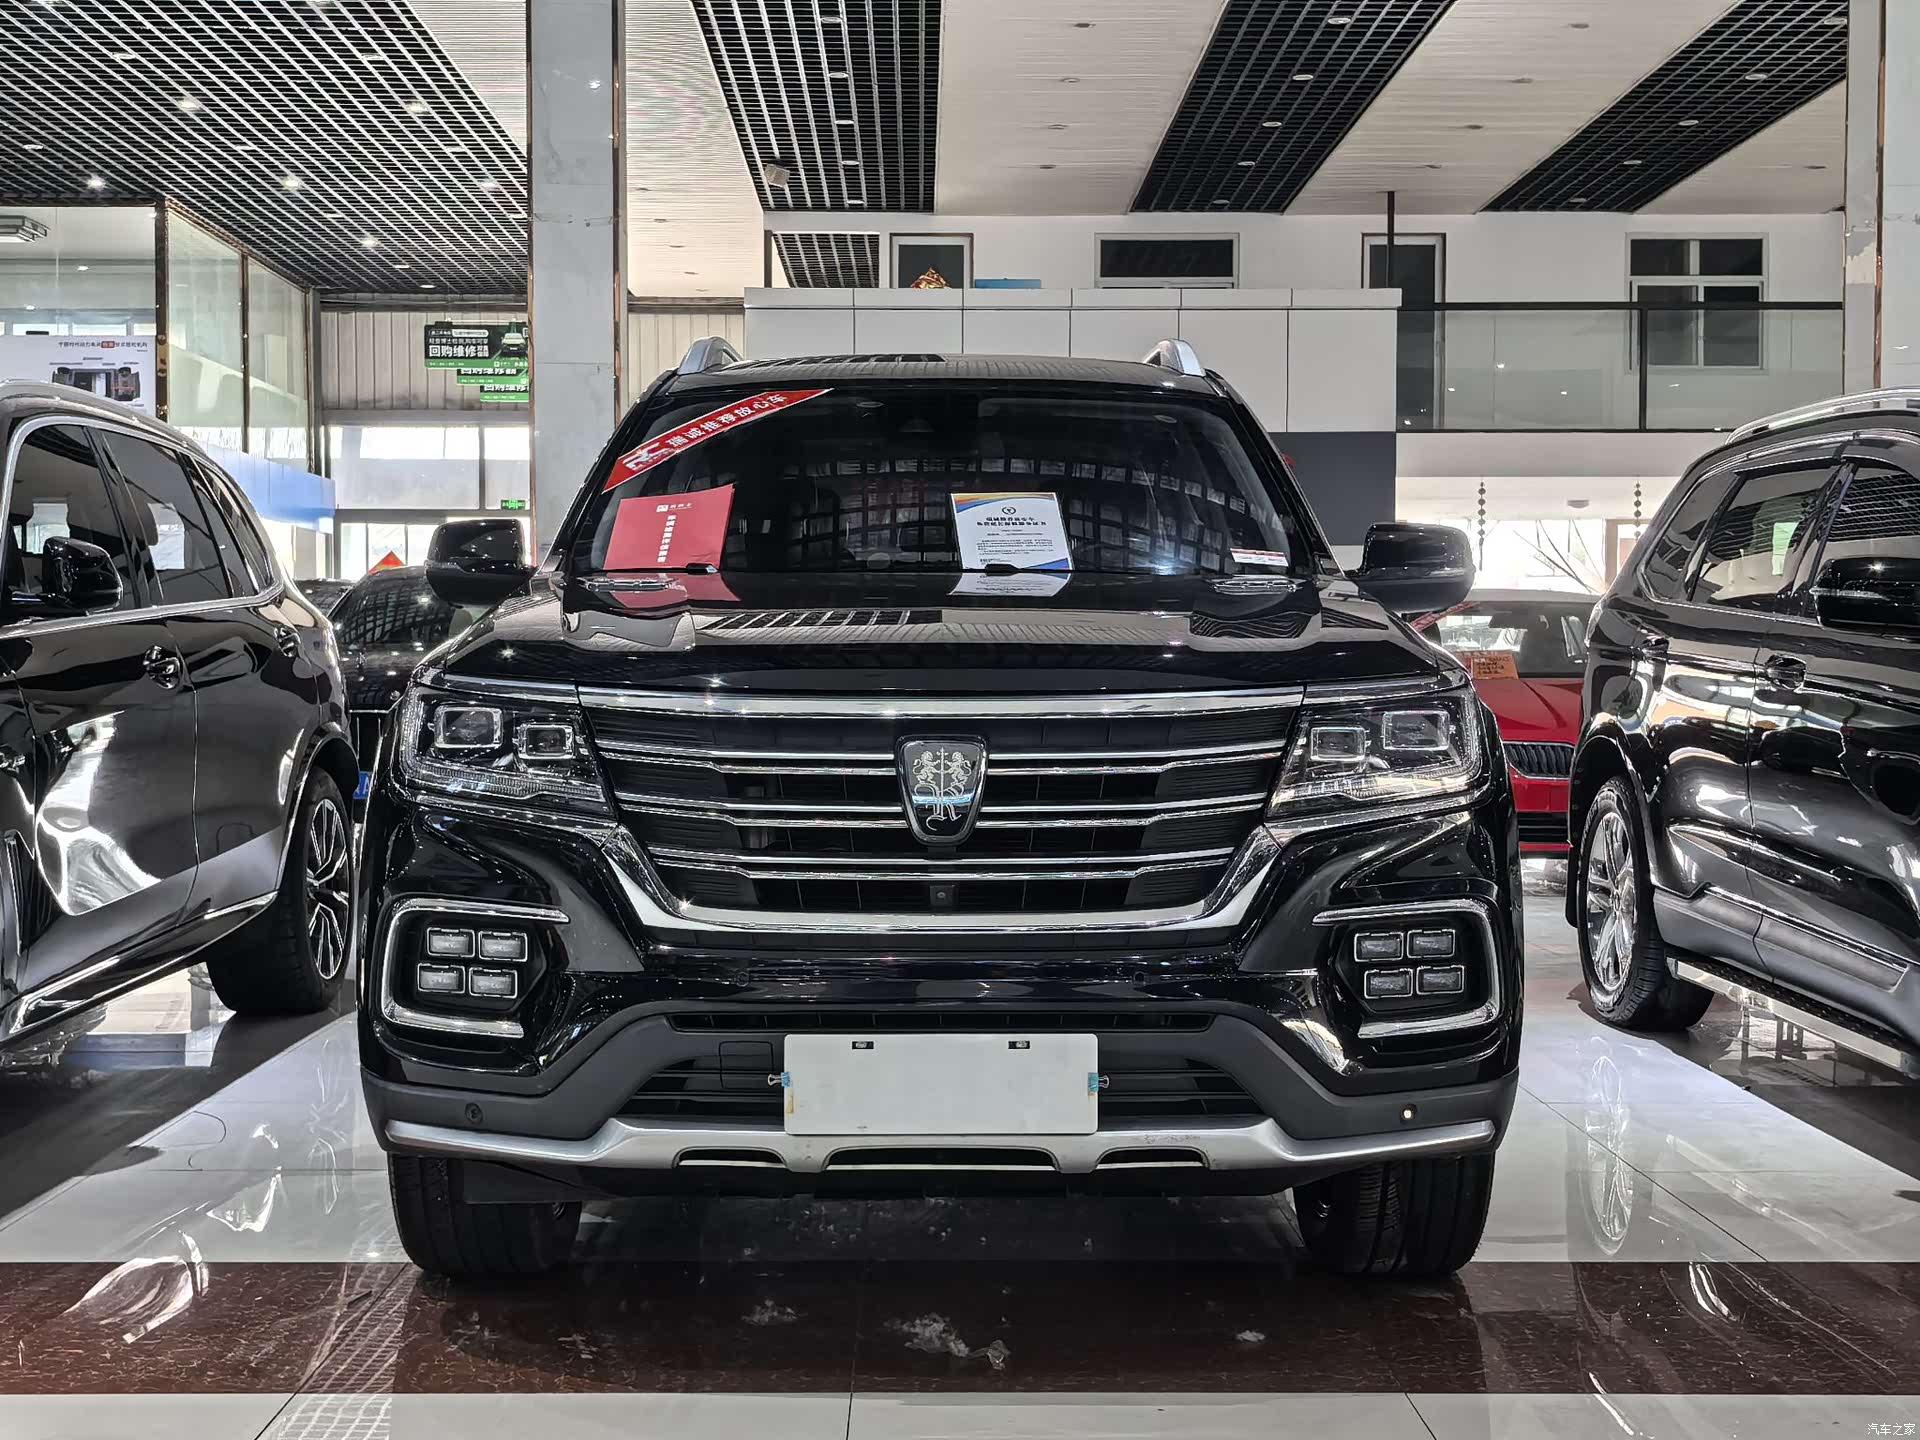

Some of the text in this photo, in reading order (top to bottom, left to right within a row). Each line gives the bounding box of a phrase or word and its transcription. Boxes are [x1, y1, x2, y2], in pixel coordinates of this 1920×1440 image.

[429, 345, 477, 357] 回购维修
[666, 393, 788, 448] 瑞诚推荐放心车
